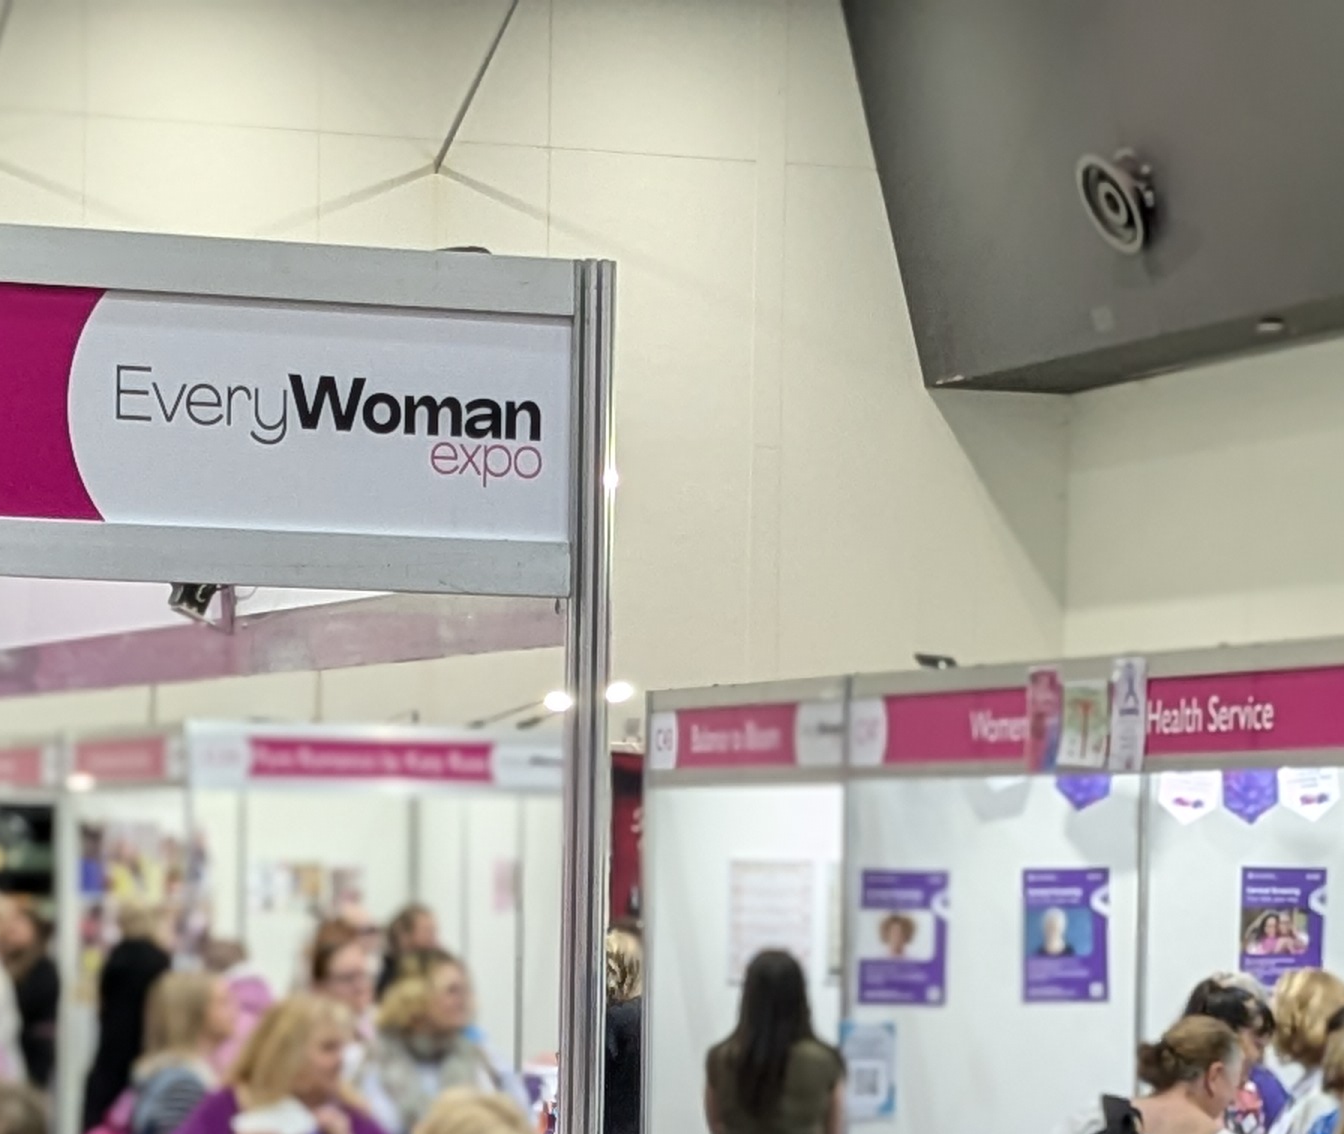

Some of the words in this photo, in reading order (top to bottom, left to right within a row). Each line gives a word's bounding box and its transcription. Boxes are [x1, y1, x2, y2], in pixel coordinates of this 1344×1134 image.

[115, 363, 543, 446] EveryWoman
[430, 441, 544, 488] expo
[1146, 697, 1203, 734] Health
[1207, 694, 1274, 733] Service
